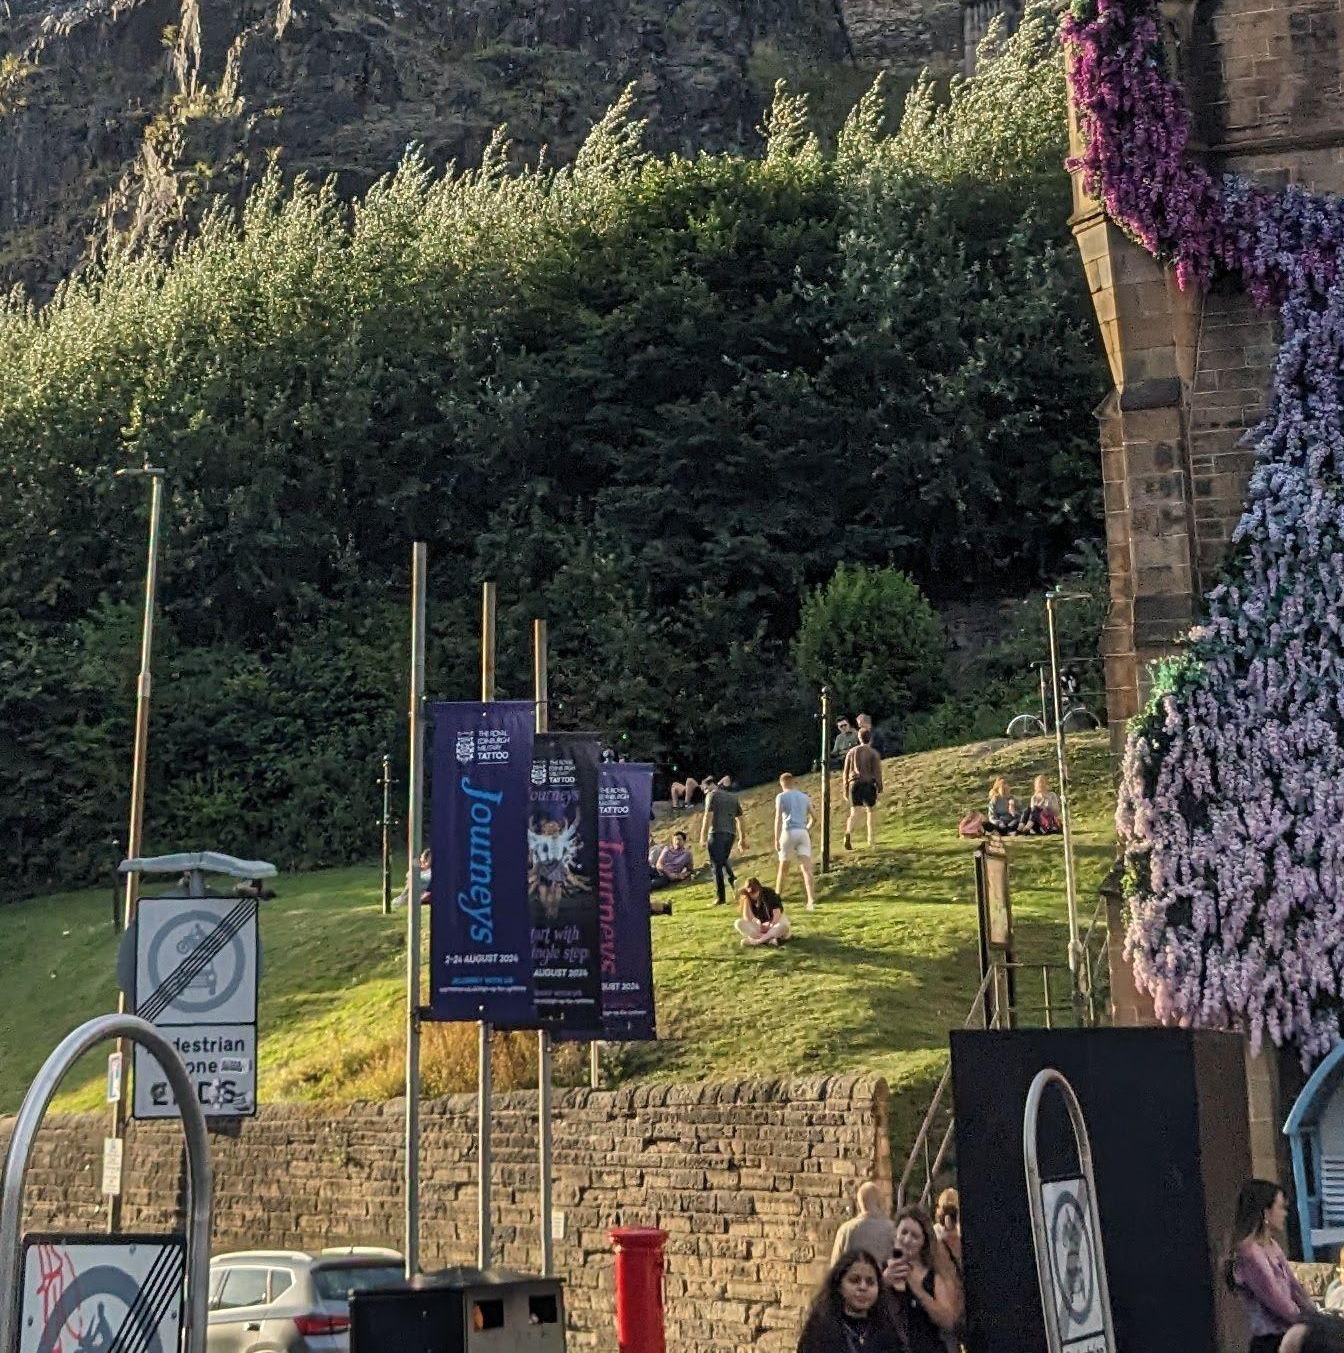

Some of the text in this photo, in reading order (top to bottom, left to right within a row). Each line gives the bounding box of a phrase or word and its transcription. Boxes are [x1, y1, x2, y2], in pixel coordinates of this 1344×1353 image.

[477, 751, 509, 760] TATTOO
[529, 789, 580, 808] ourneys
[599, 806, 629, 814] TATTOO
[458, 776, 504, 944] Journeys
[464, 954, 498, 963] AUGUST
[533, 969, 567, 977] AUGUST
[170, 1036, 245, 1053] destrian
[186, 1060, 218, 1074] one
